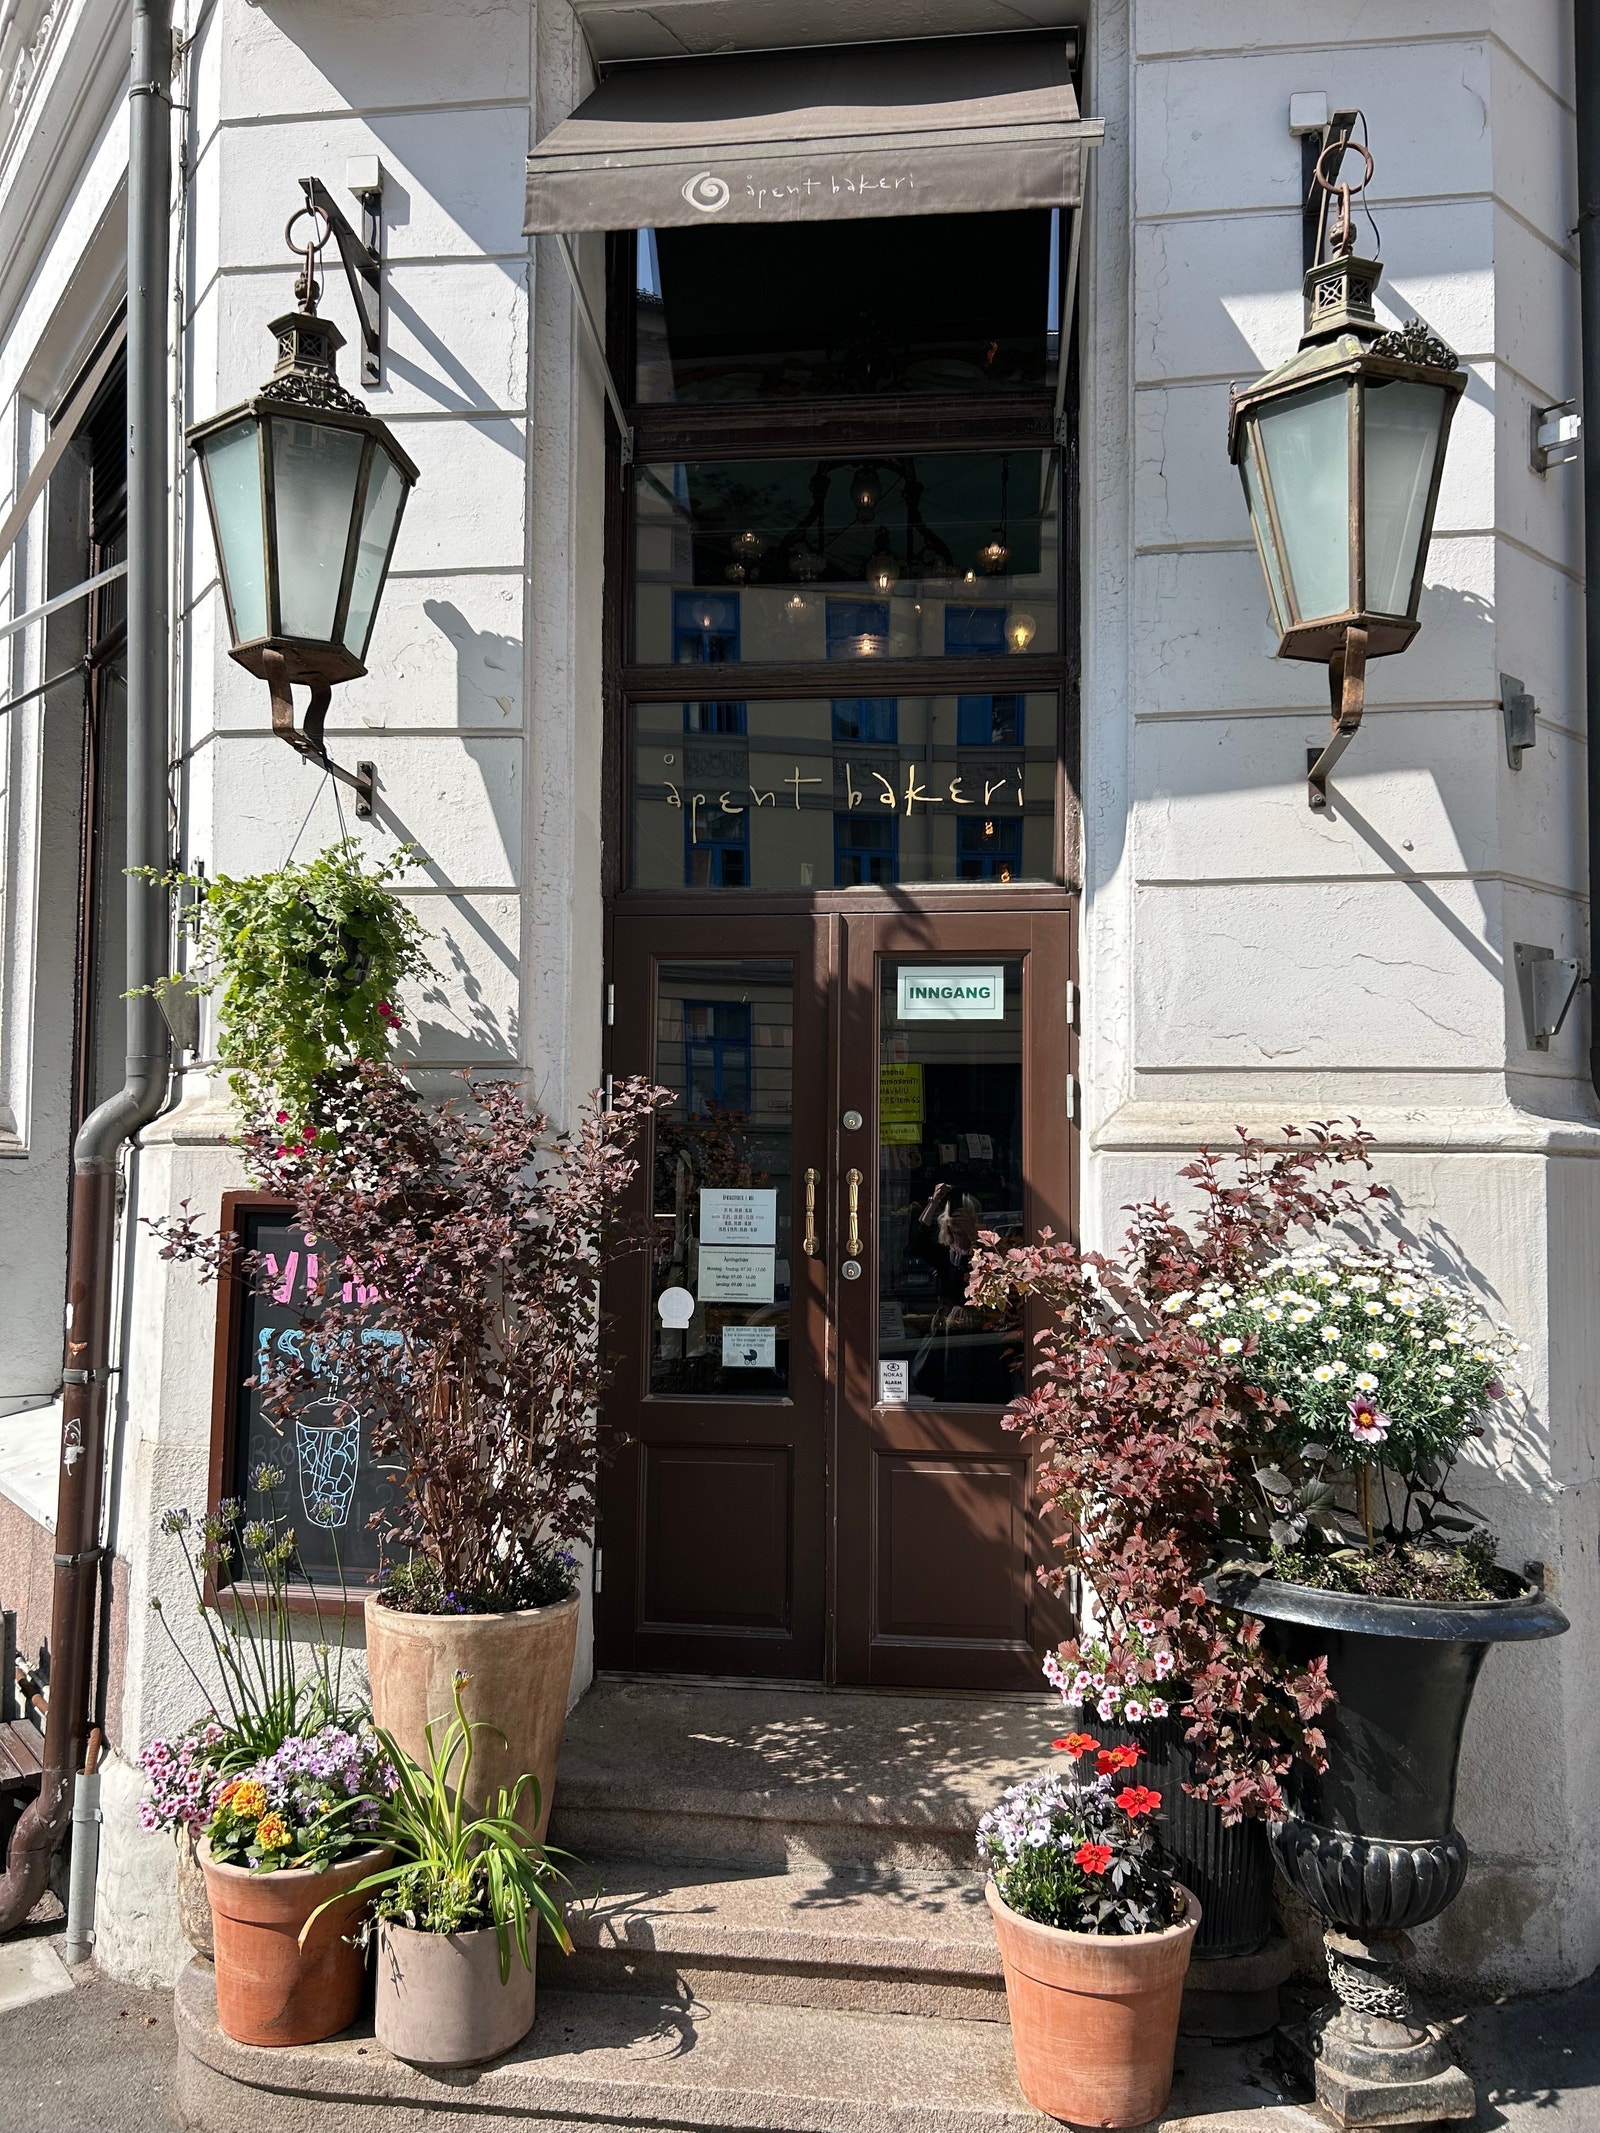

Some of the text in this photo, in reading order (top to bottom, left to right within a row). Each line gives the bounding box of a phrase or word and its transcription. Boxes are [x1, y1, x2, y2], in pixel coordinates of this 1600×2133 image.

[746, 172, 914, 209] åpent bakeri
[662, 753, 1023, 844] åpent bakeri
[909, 986, 991, 999] INNGANG
